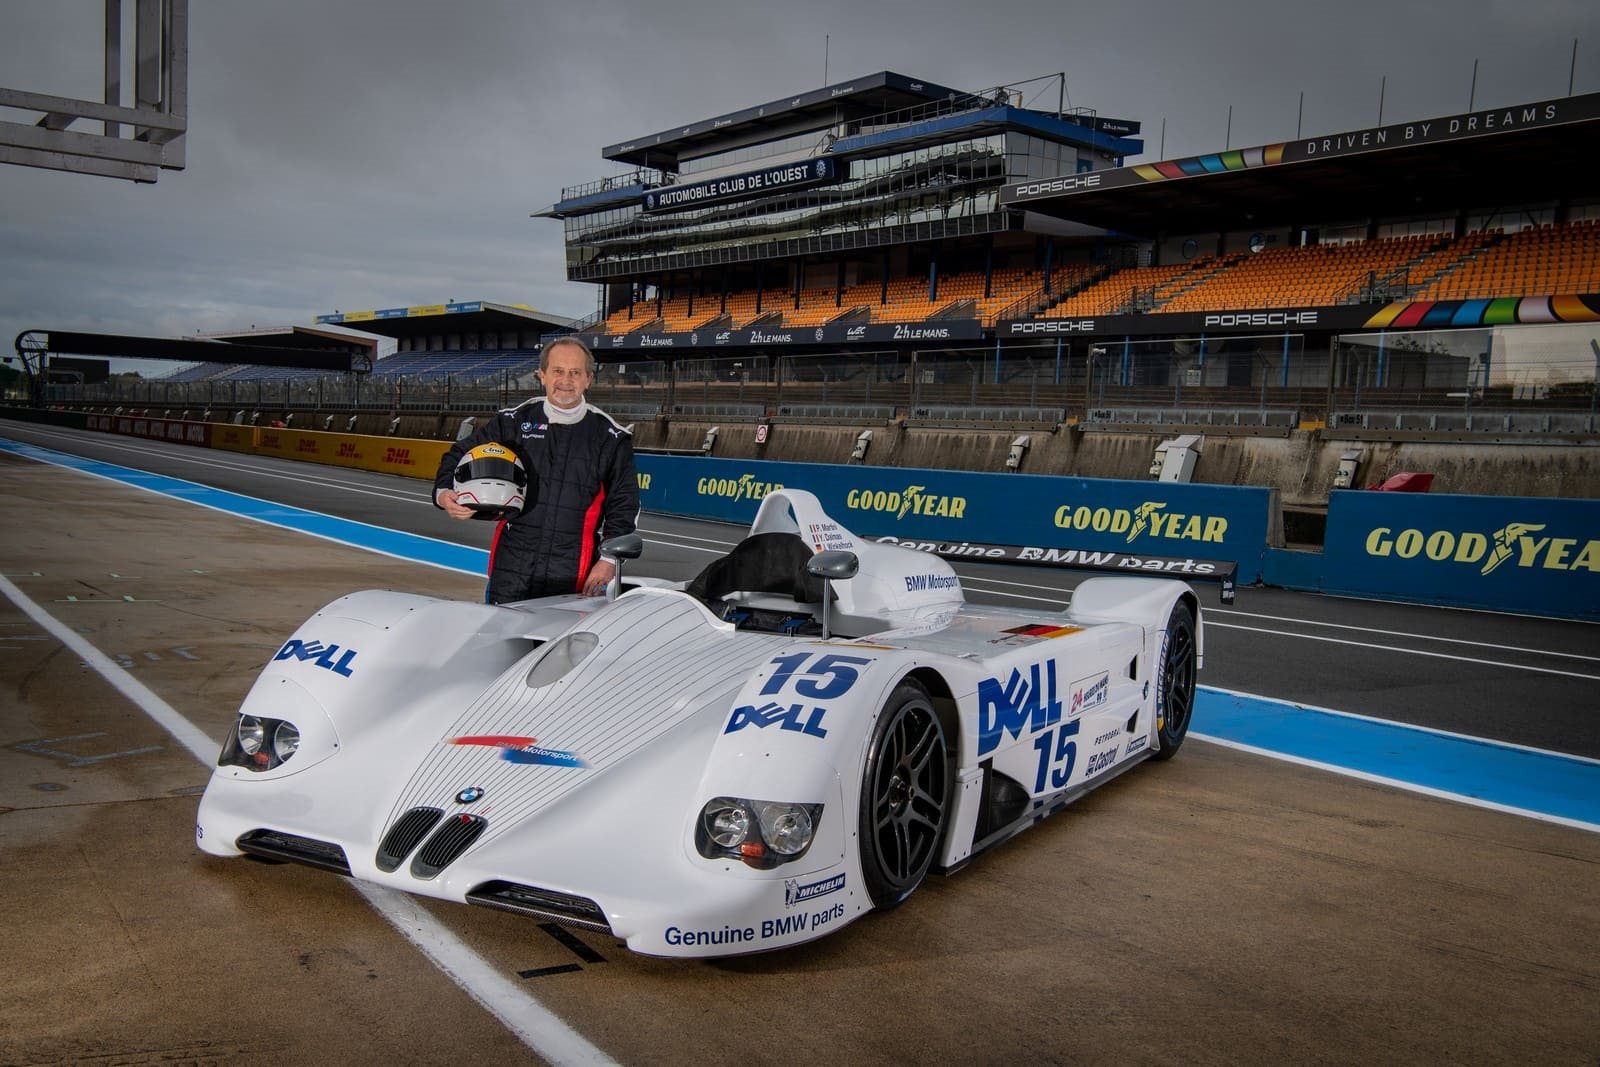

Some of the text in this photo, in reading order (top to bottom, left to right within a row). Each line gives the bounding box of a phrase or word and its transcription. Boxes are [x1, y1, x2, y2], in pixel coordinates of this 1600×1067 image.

[1307, 105, 1557, 154] DRIVEN BY DREAMS
[660, 165, 809, 206] AUTOMOBILE CLUB DE L'OUEST
[1016, 175, 1101, 197] PORSCHE
[1011, 320, 1095, 333] PORSCHE
[1205, 311, 1318, 327] PORSCHE
[657, 338, 673, 346] MANS
[771, 334, 792, 343] MANS
[910, 330, 921, 339] LE
[922, 328, 949, 339] MANS
[1016, 547, 1115, 566] BMW
[1118, 556, 1216, 574] parts
[904, 575, 927, 592] BMW
[273, 639, 358, 678] DELL
[759, 652, 872, 700] 15
[977, 658, 1063, 757] DELL
[1070, 688, 1083, 714] 24
[723, 702, 828, 739] DELL
[1033, 718, 1081, 794] 15
[799, 876, 845, 898] MICHELIN
[664, 902, 844, 946] Genuine BMW parts
